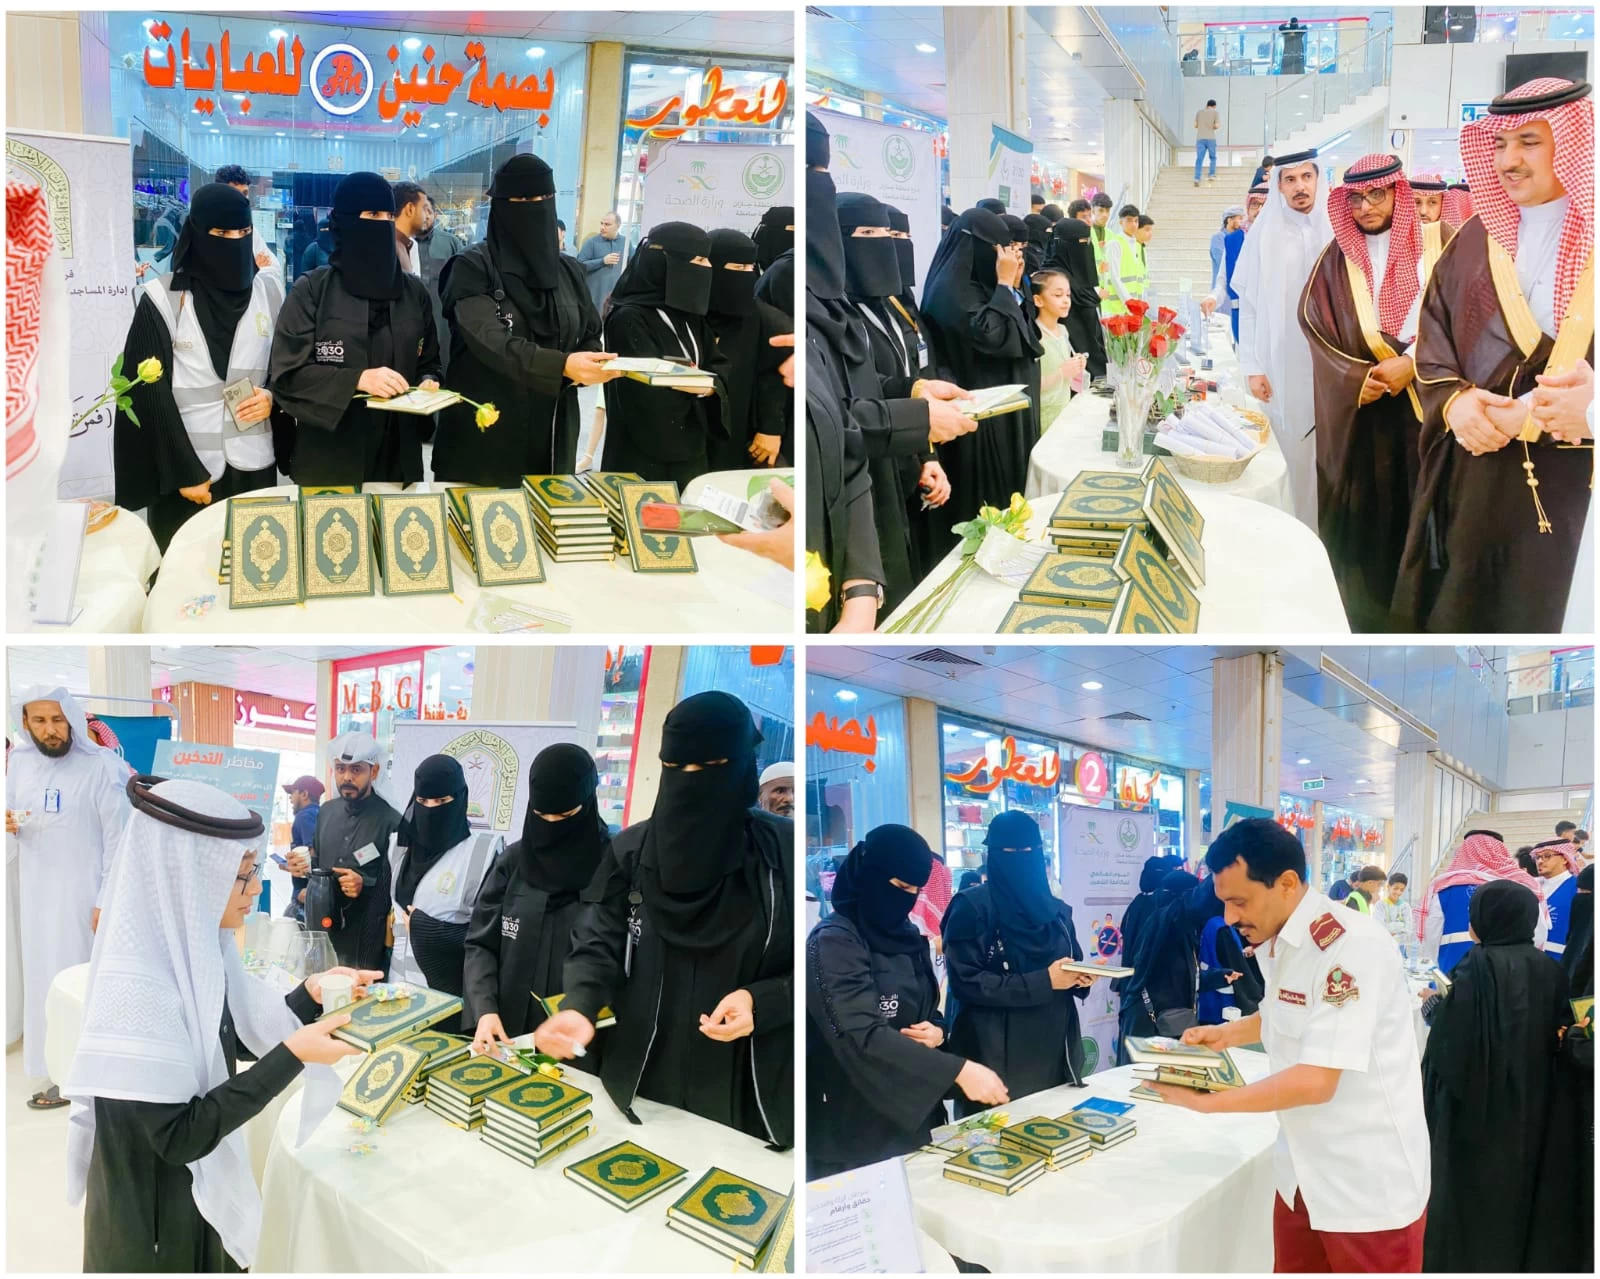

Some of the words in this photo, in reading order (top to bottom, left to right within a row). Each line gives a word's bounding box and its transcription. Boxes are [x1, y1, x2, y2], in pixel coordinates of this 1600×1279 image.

[143, 20, 306, 117] للعبايات
[377, 44, 464, 129] حنين
[464, 40, 555, 128] بصمة
[625, 65, 788, 139] للعطور
[69, 285, 106, 297] المساجد
[108, 285, 128, 297] إدارة
[341, 675, 413, 714] M.B.G
[173, 750, 224, 766] التدخين
[224, 755, 264, 770] مخاطر
[806, 711, 878, 774] بصم
[944, 735, 1061, 793] للعطور
[1084, 760, 1102, 793] 2
